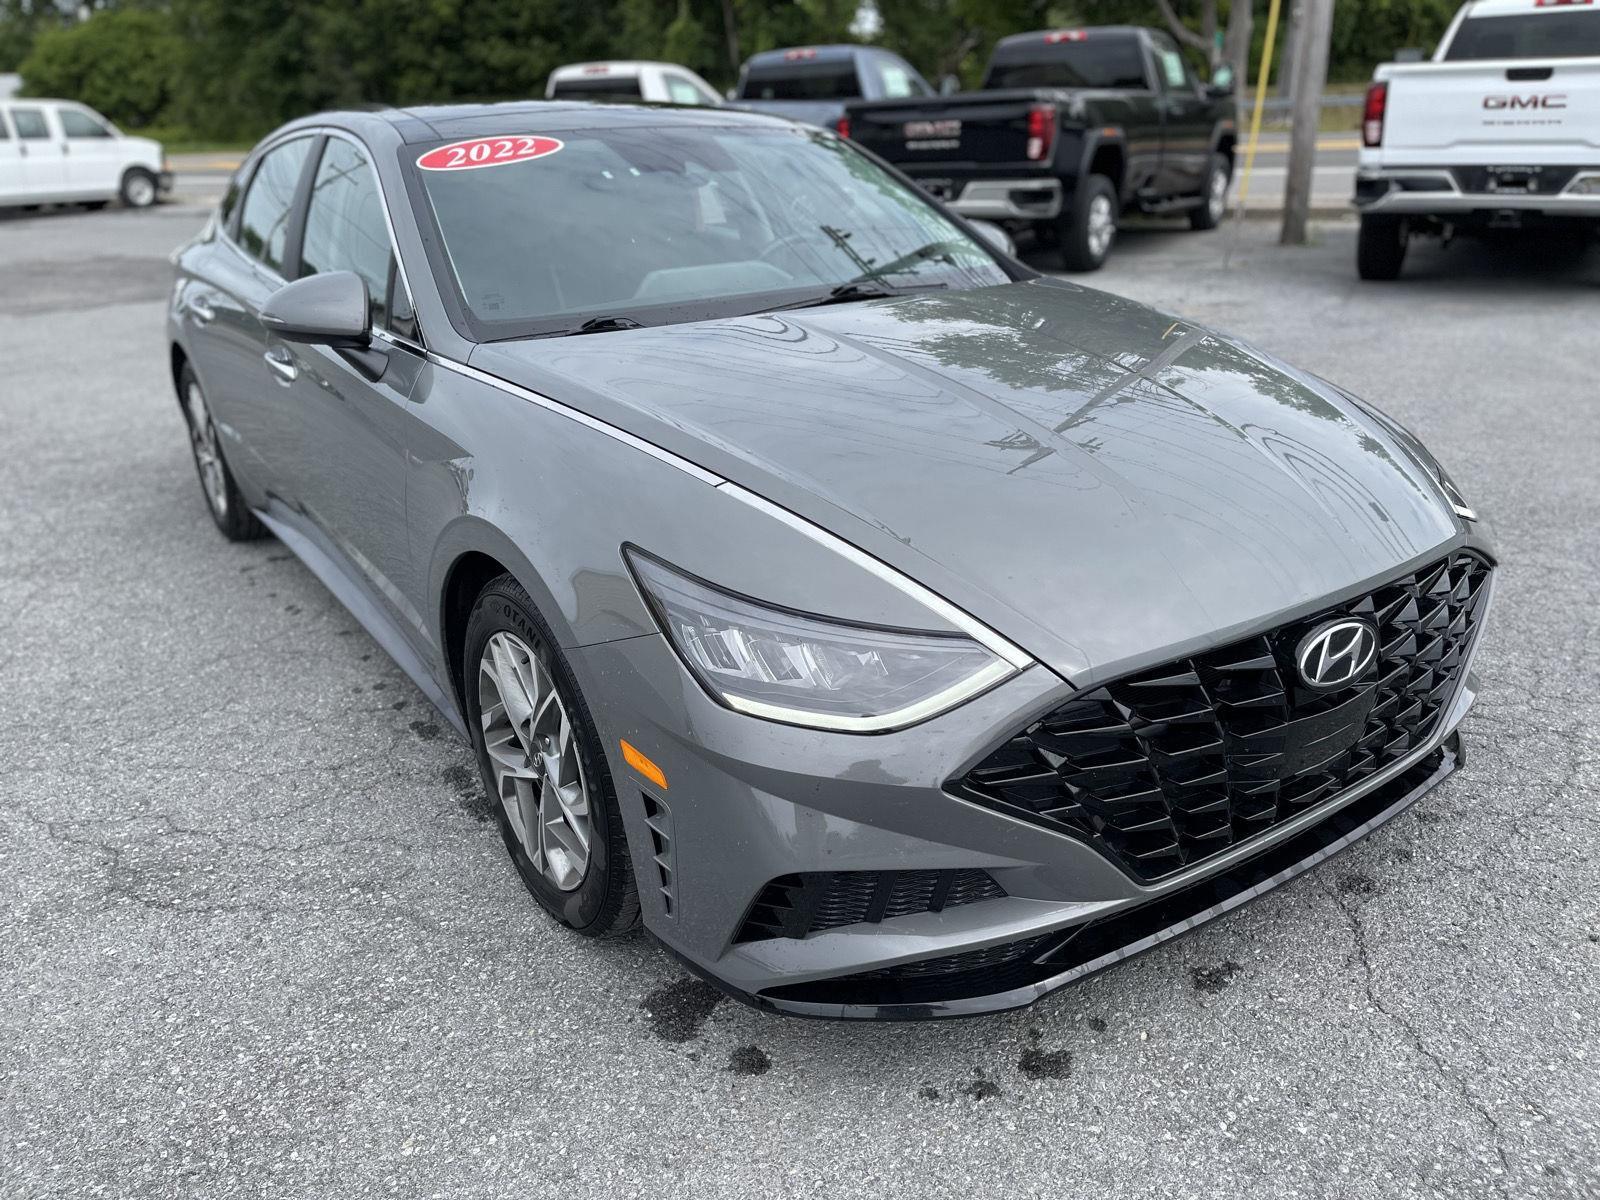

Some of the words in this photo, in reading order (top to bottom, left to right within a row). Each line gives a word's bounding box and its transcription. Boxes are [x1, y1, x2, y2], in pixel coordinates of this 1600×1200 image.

[1483, 95, 1567, 109] GMC
[446, 138, 536, 167] 2022
[503, 604, 541, 650] OTANI
